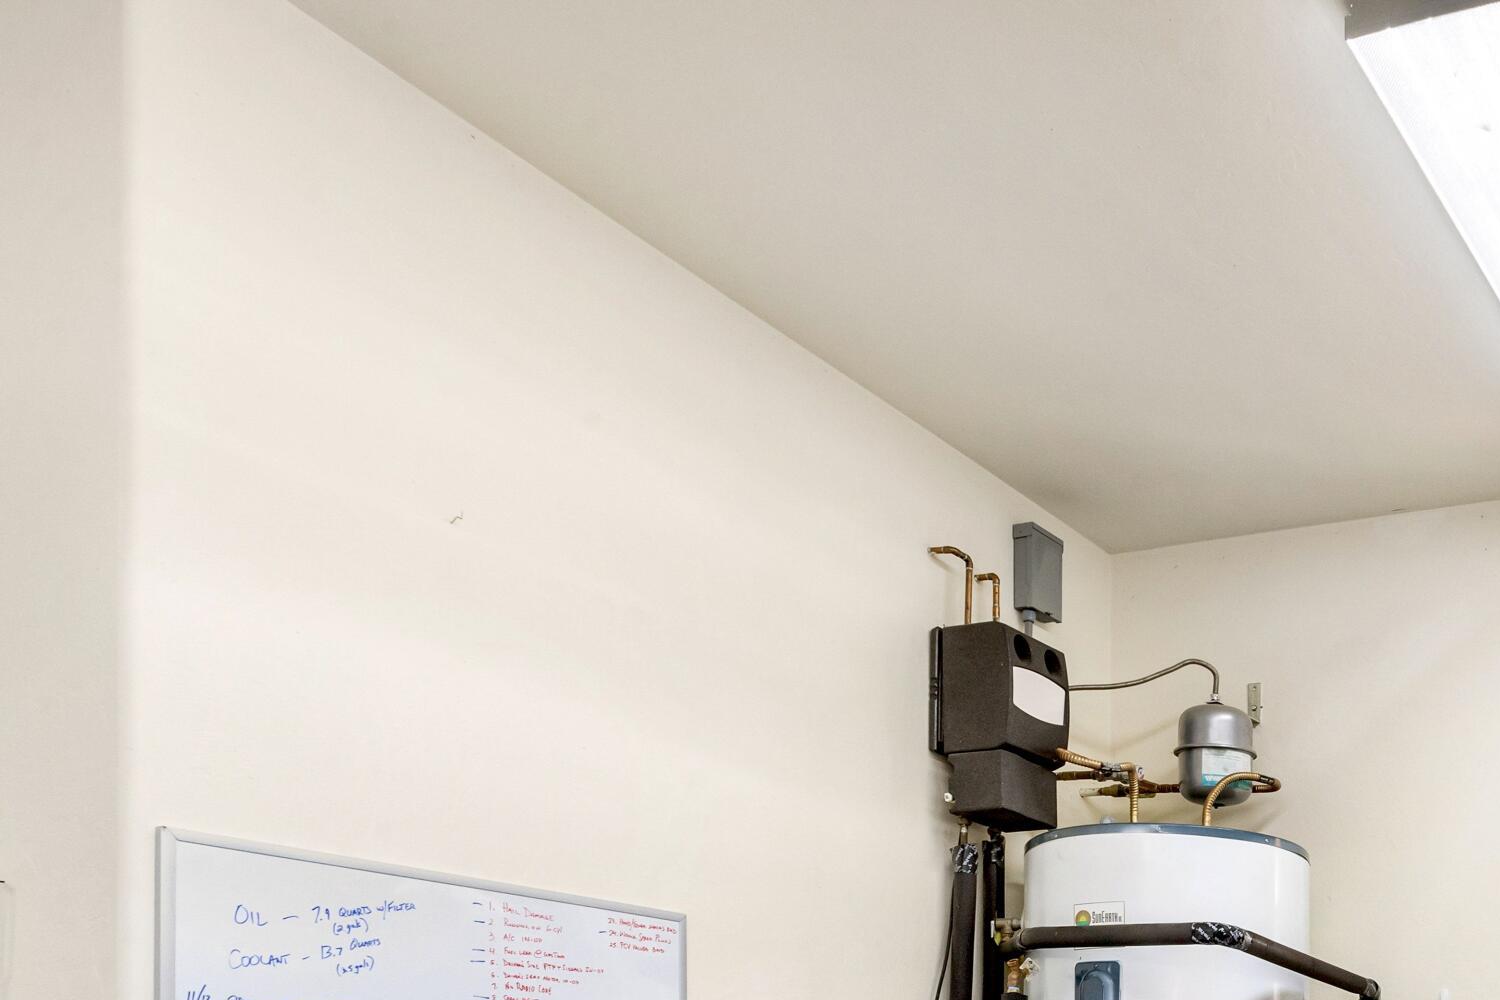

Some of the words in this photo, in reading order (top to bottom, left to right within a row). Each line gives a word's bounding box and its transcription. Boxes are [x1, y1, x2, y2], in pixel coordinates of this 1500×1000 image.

[233, 904, 268, 927] OIL
[339, 906, 372, 917] QUARTS
[228, 948, 291, 970] COOLANT
